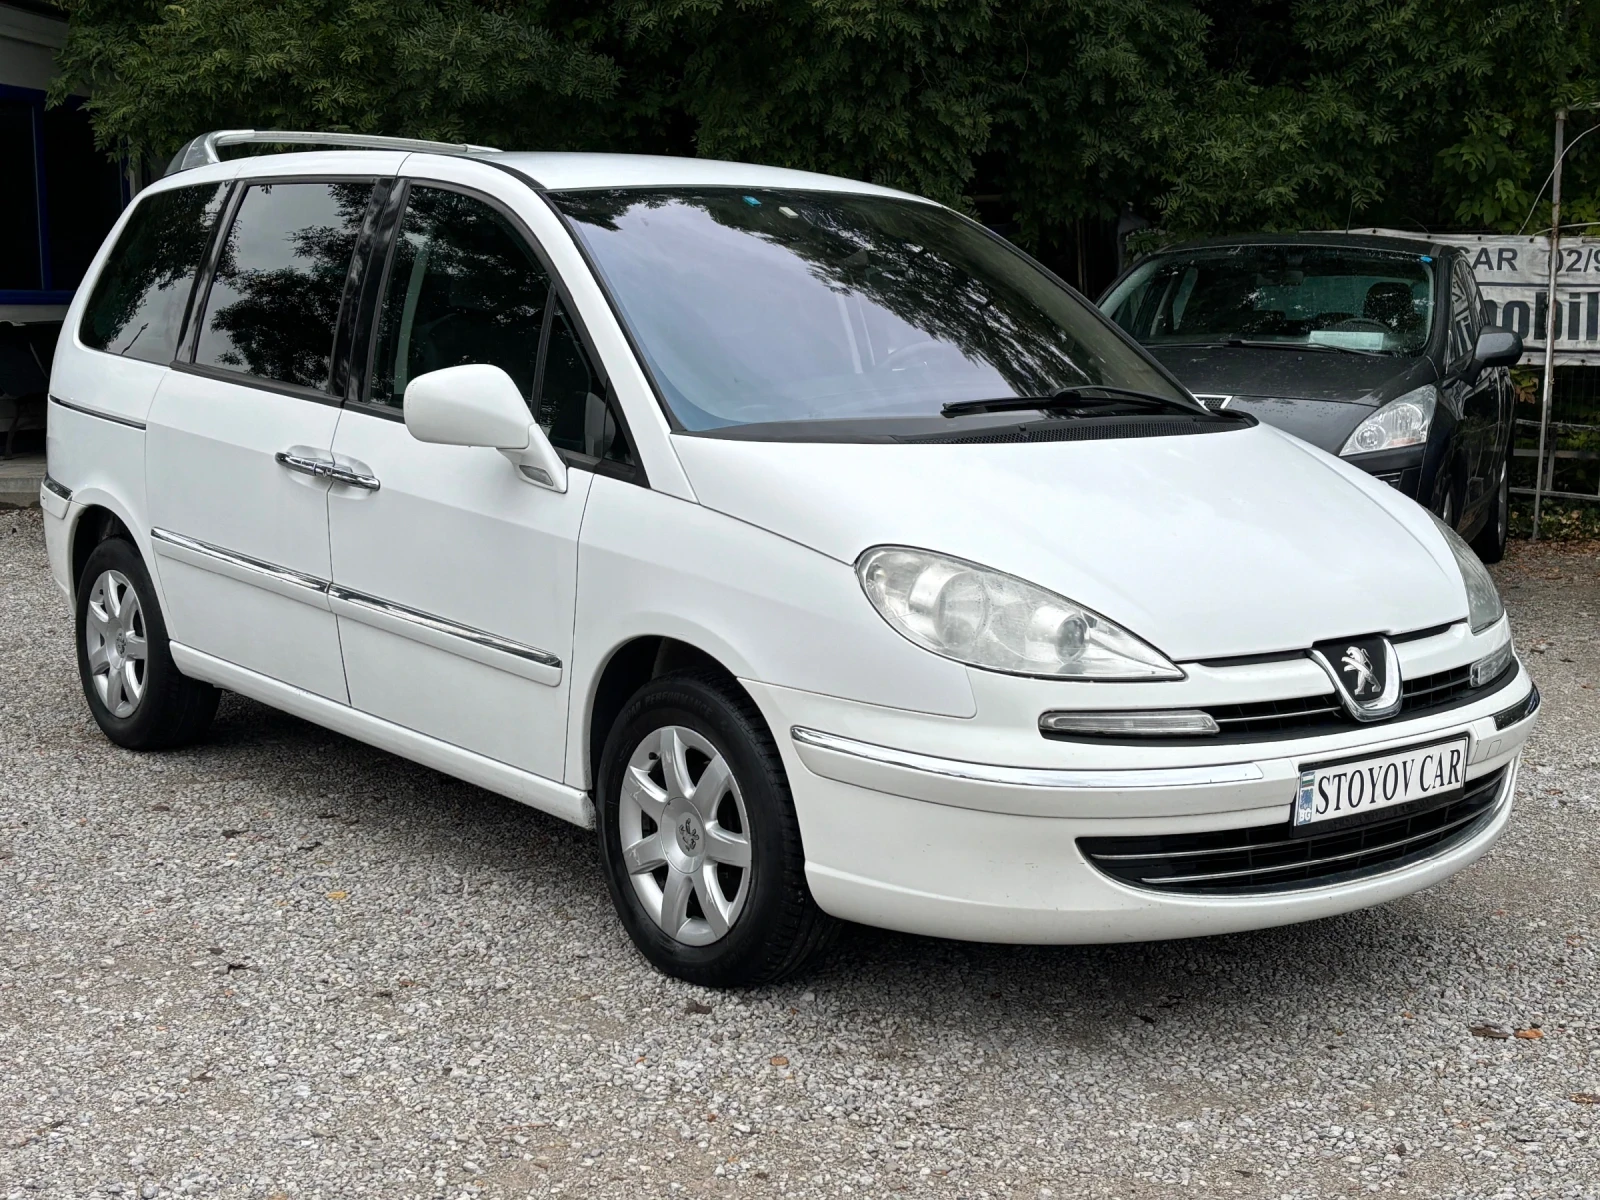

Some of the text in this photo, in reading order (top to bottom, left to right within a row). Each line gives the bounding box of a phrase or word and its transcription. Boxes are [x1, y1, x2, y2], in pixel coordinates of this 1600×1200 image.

[1459, 246, 1518, 272] AR
[1316, 758, 1416, 815] STOYOV
[1419, 749, 1461, 793] CAR
[1298, 809, 1311, 822] BG
